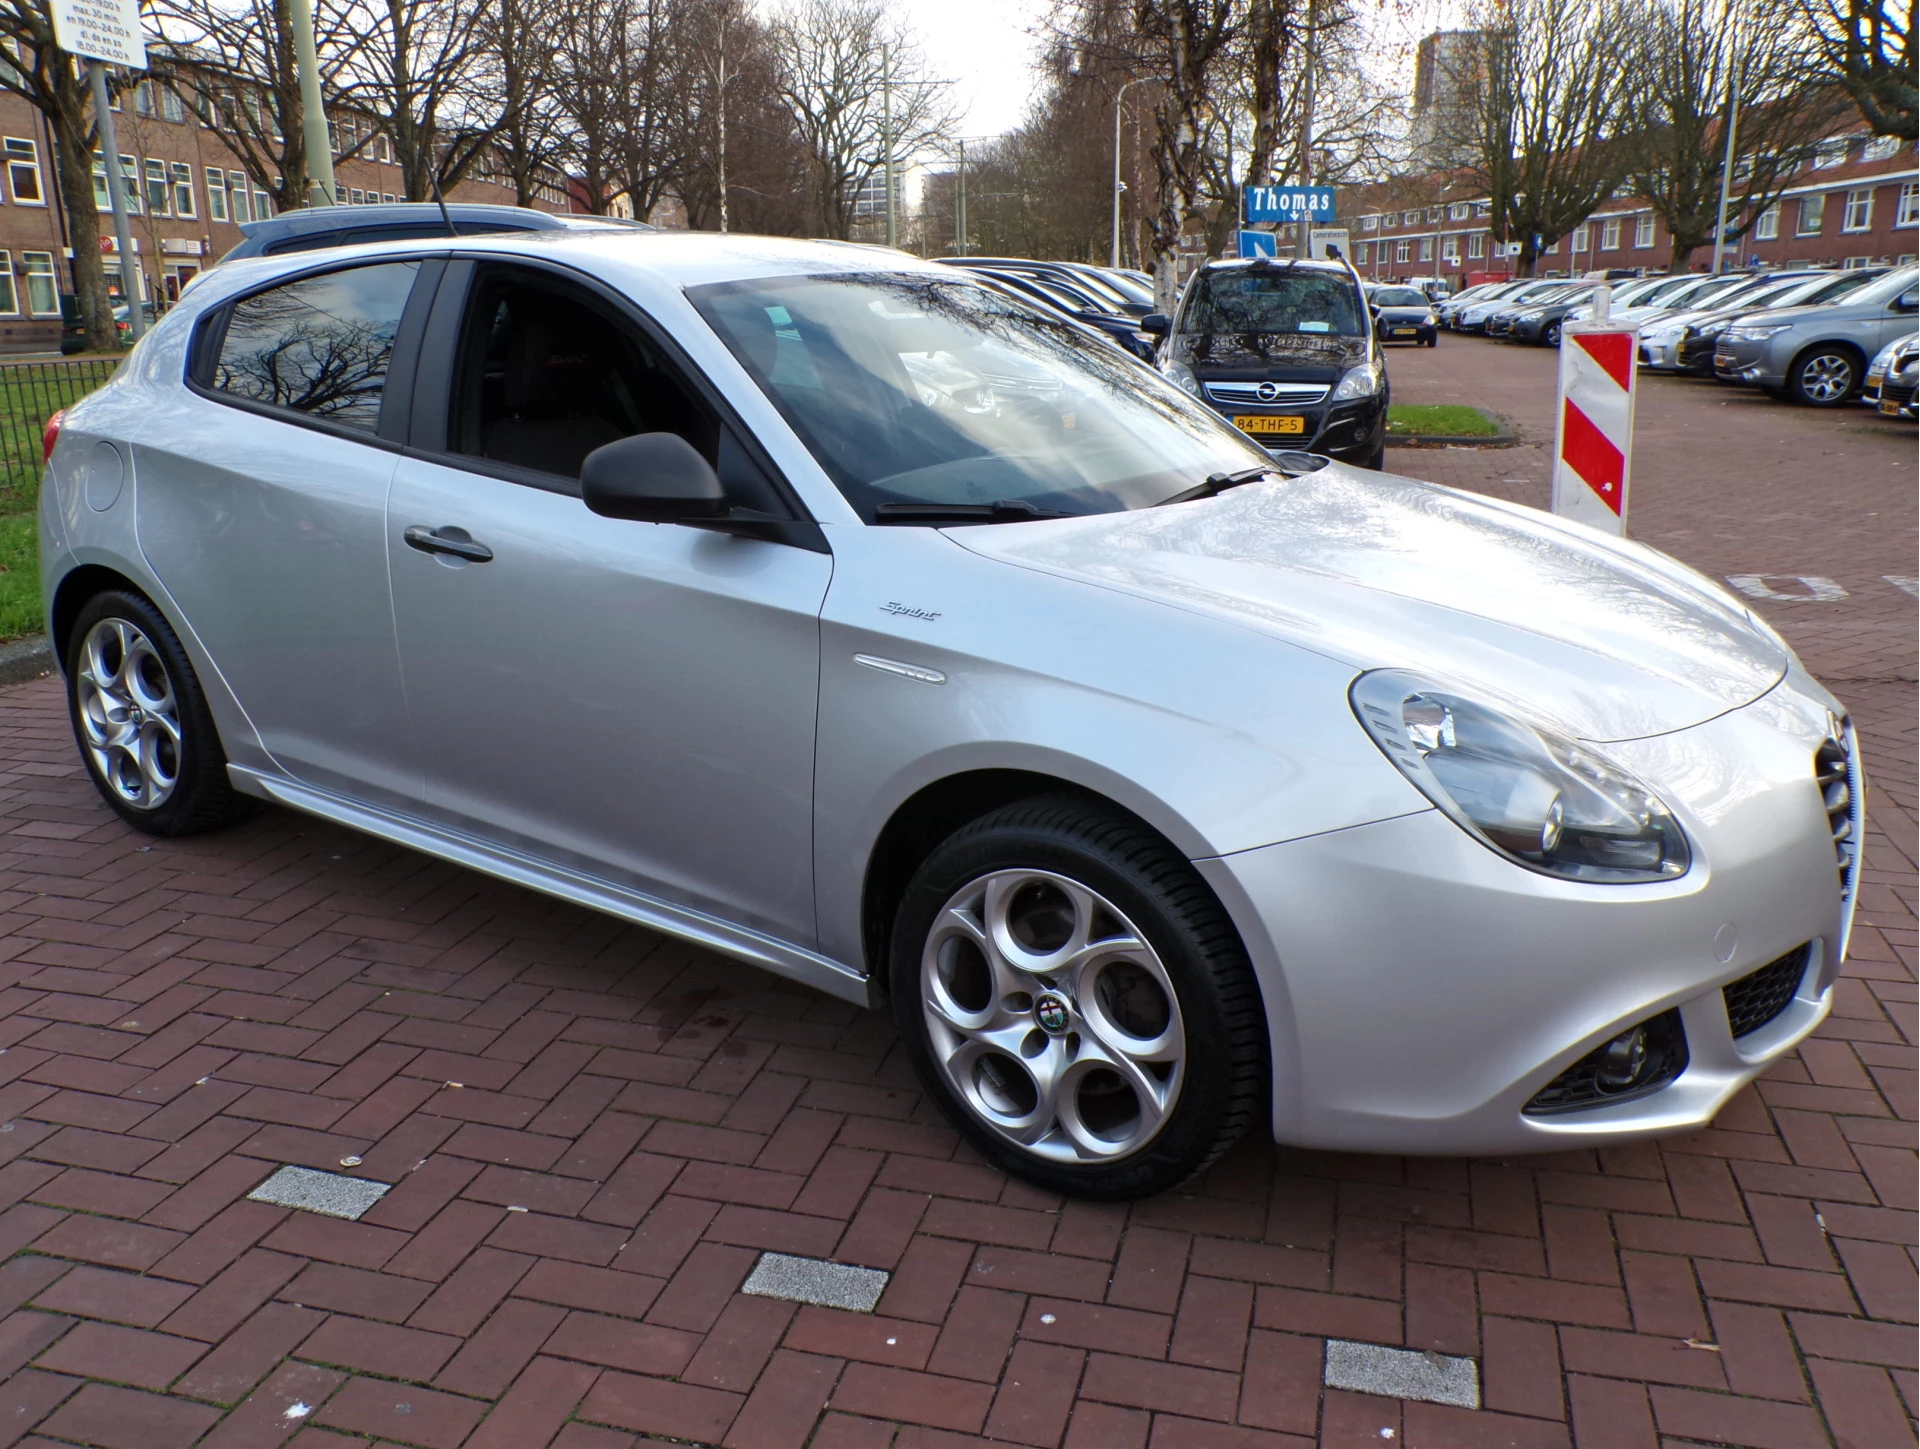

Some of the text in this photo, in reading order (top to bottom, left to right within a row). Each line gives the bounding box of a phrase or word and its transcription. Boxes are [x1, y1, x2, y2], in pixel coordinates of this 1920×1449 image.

[72, 5, 120, 24] max. 30 min.
[66, 15, 131, 38] en 19.00-24.00 h
[102, 36, 112, 45] en
[124, 52, 130, 61] h
[1253, 187, 1330, 211] Thomas
[1237, 418, 1298, 431] 84-THF-5
[879, 600, 942, 621] Sprint
